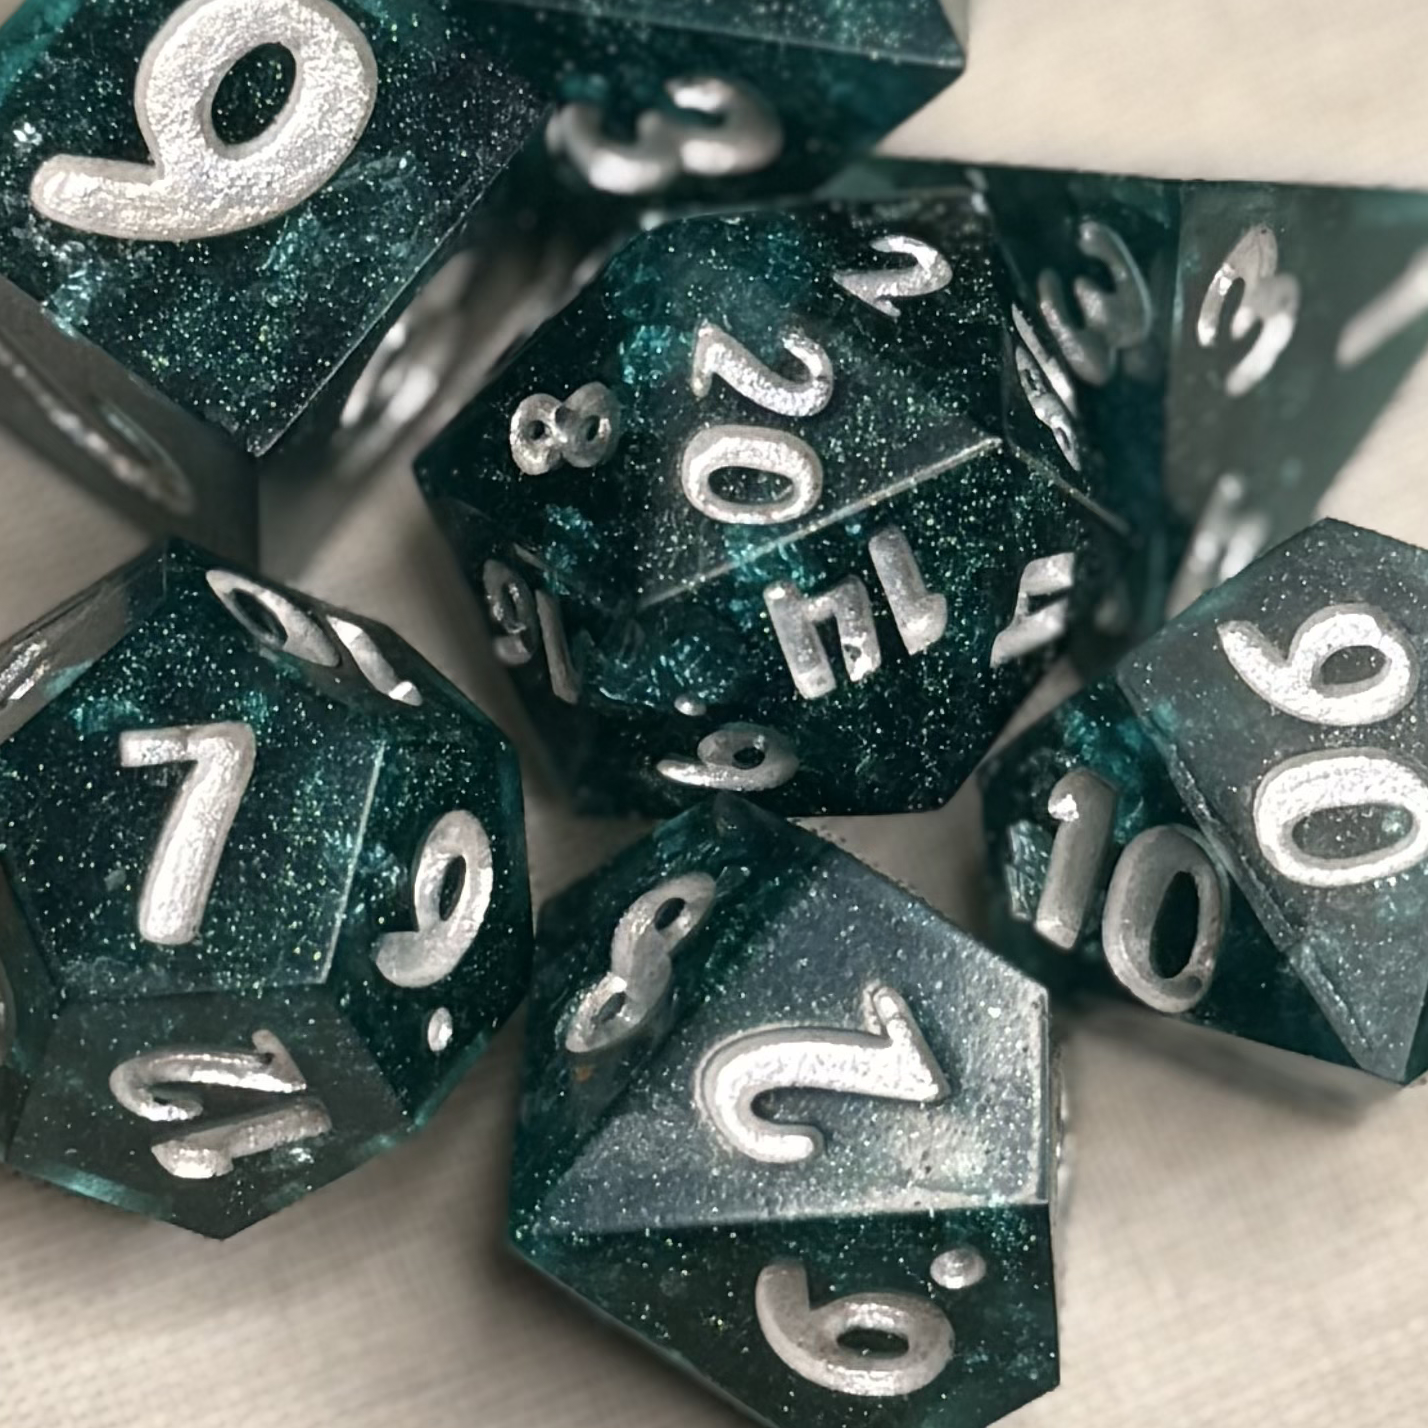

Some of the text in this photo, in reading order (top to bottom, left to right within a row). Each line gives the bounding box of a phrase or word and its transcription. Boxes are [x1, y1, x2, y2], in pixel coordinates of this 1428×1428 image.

[832, 232, 954, 319] 2
[508, 380, 622, 476] 8
[680, 316, 836, 528] 20
[762, 524, 950, 702] 14
[118, 720, 258, 948] 7
[1032, 766, 1232, 1016] 10
[562, 870, 718, 1056] 8
[106, 1026, 336, 1182] 12
[694, 978, 954, 1166] 2
